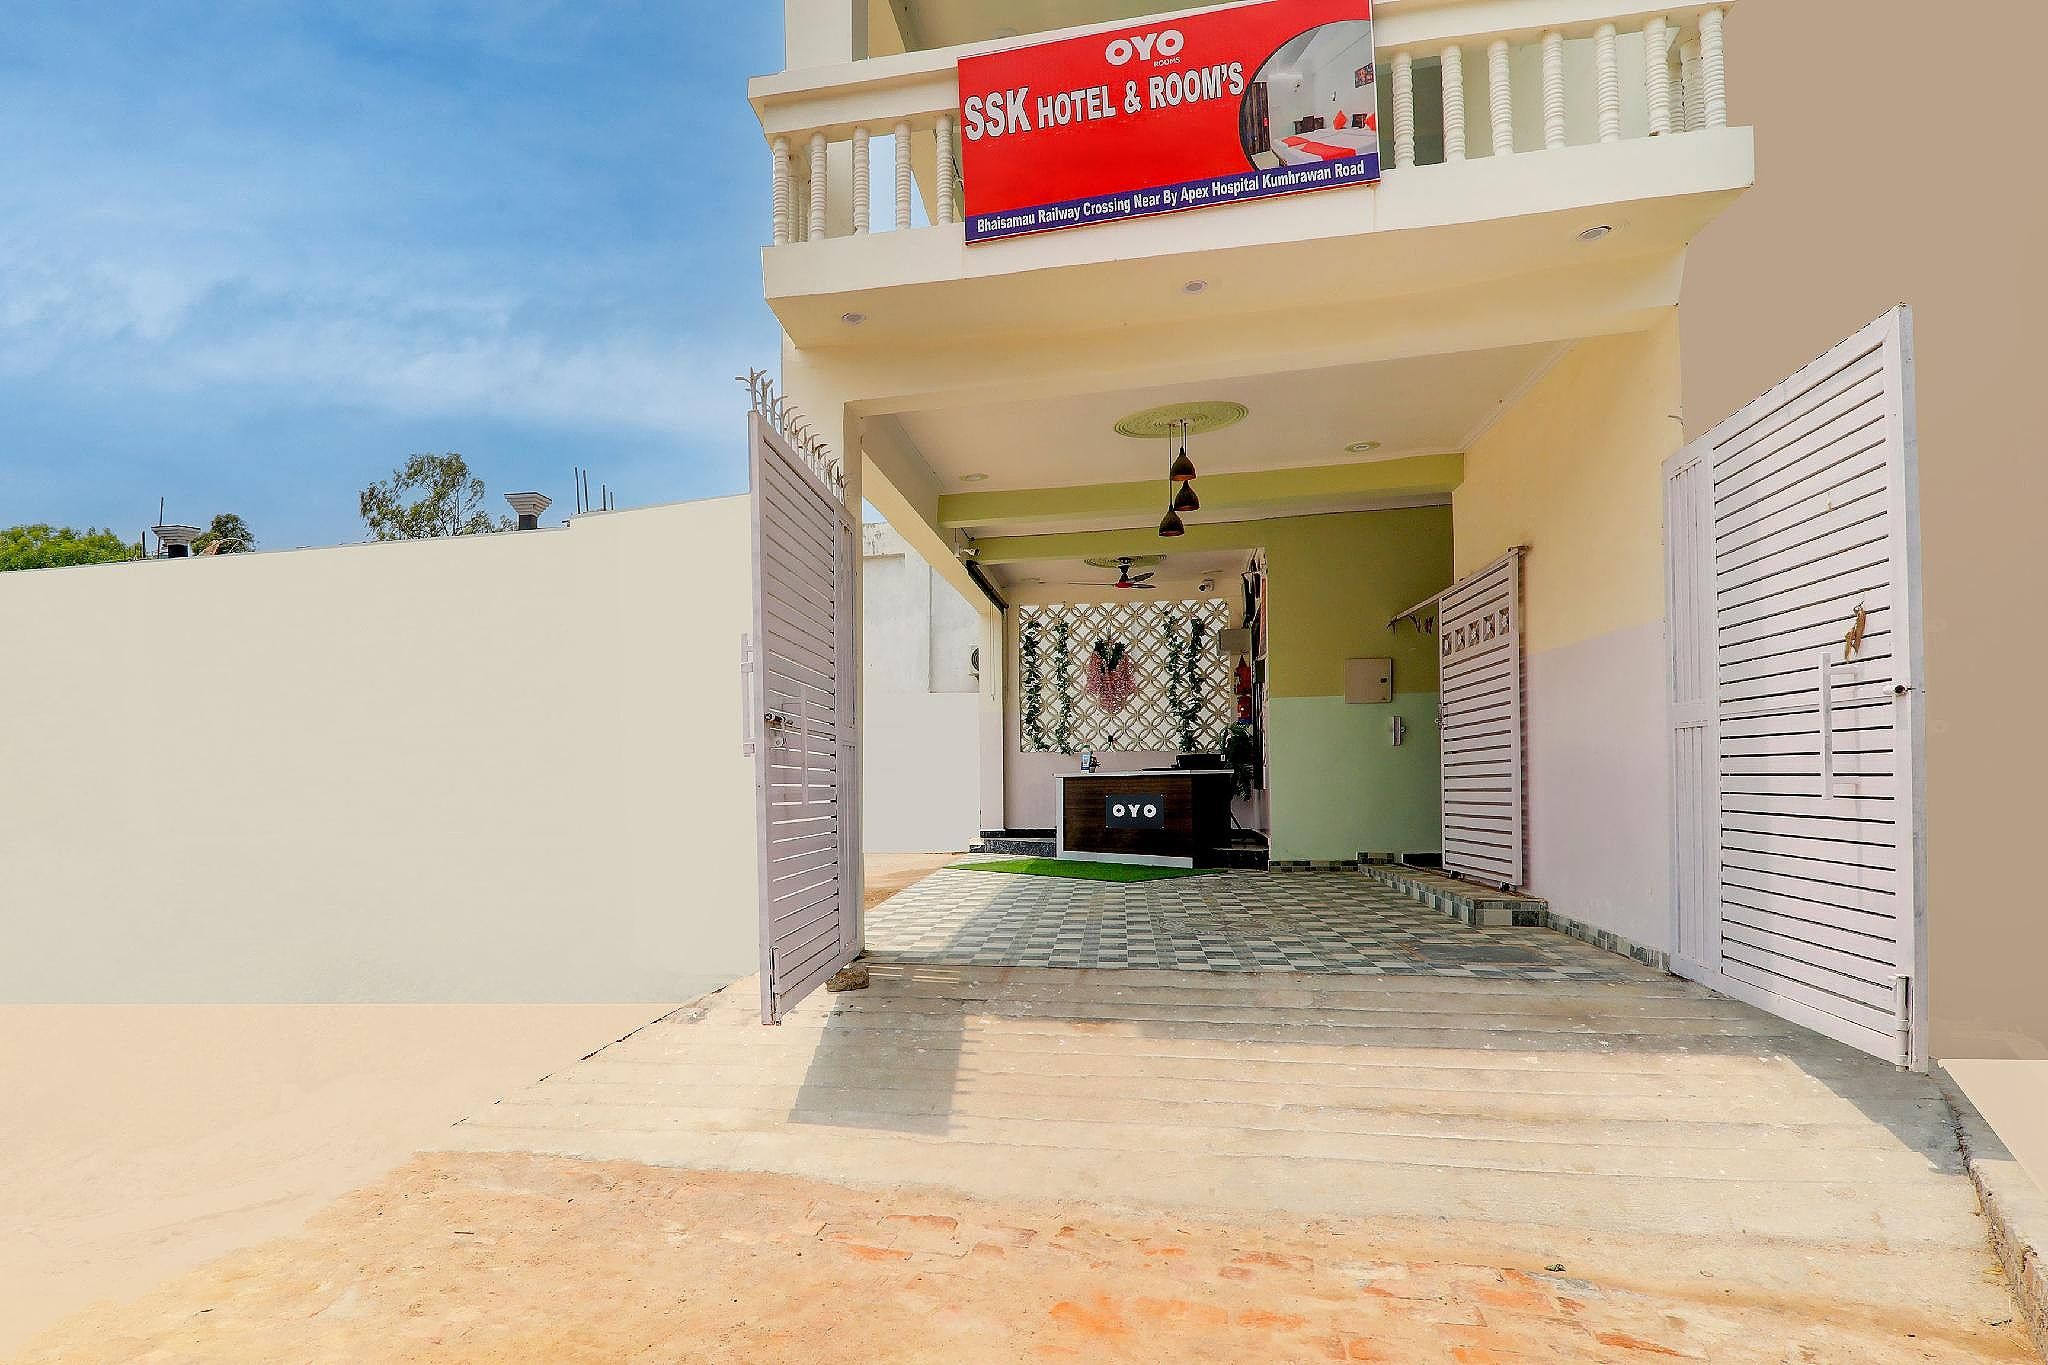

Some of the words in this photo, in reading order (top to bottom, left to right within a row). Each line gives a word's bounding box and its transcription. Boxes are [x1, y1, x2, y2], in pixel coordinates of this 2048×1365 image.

[1105, 29, 1185, 66] OYO
[1153, 57, 1182, 68] ROOMS
[964, 86, 1031, 141] SSK
[1037, 85, 1117, 129] HOTEL
[1123, 80, 1143, 113] &
[1149, 61, 1244, 109] ROOM'S
[977, 213, 1035, 233] Bhaisamau
[1038, 205, 1081, 224] Railway
[1083, 198, 1131, 216] Crossing
[1133, 192, 1161, 209] Near
[1163, 189, 1178, 206] By
[1180, 185, 1210, 202] Apex
[1211, 176, 1259, 198] Hospital
[1262, 167, 1332, 189] Kumhrawan
[1334, 160, 1365, 177] Road
[1112, 804, 1157, 818] OYO
